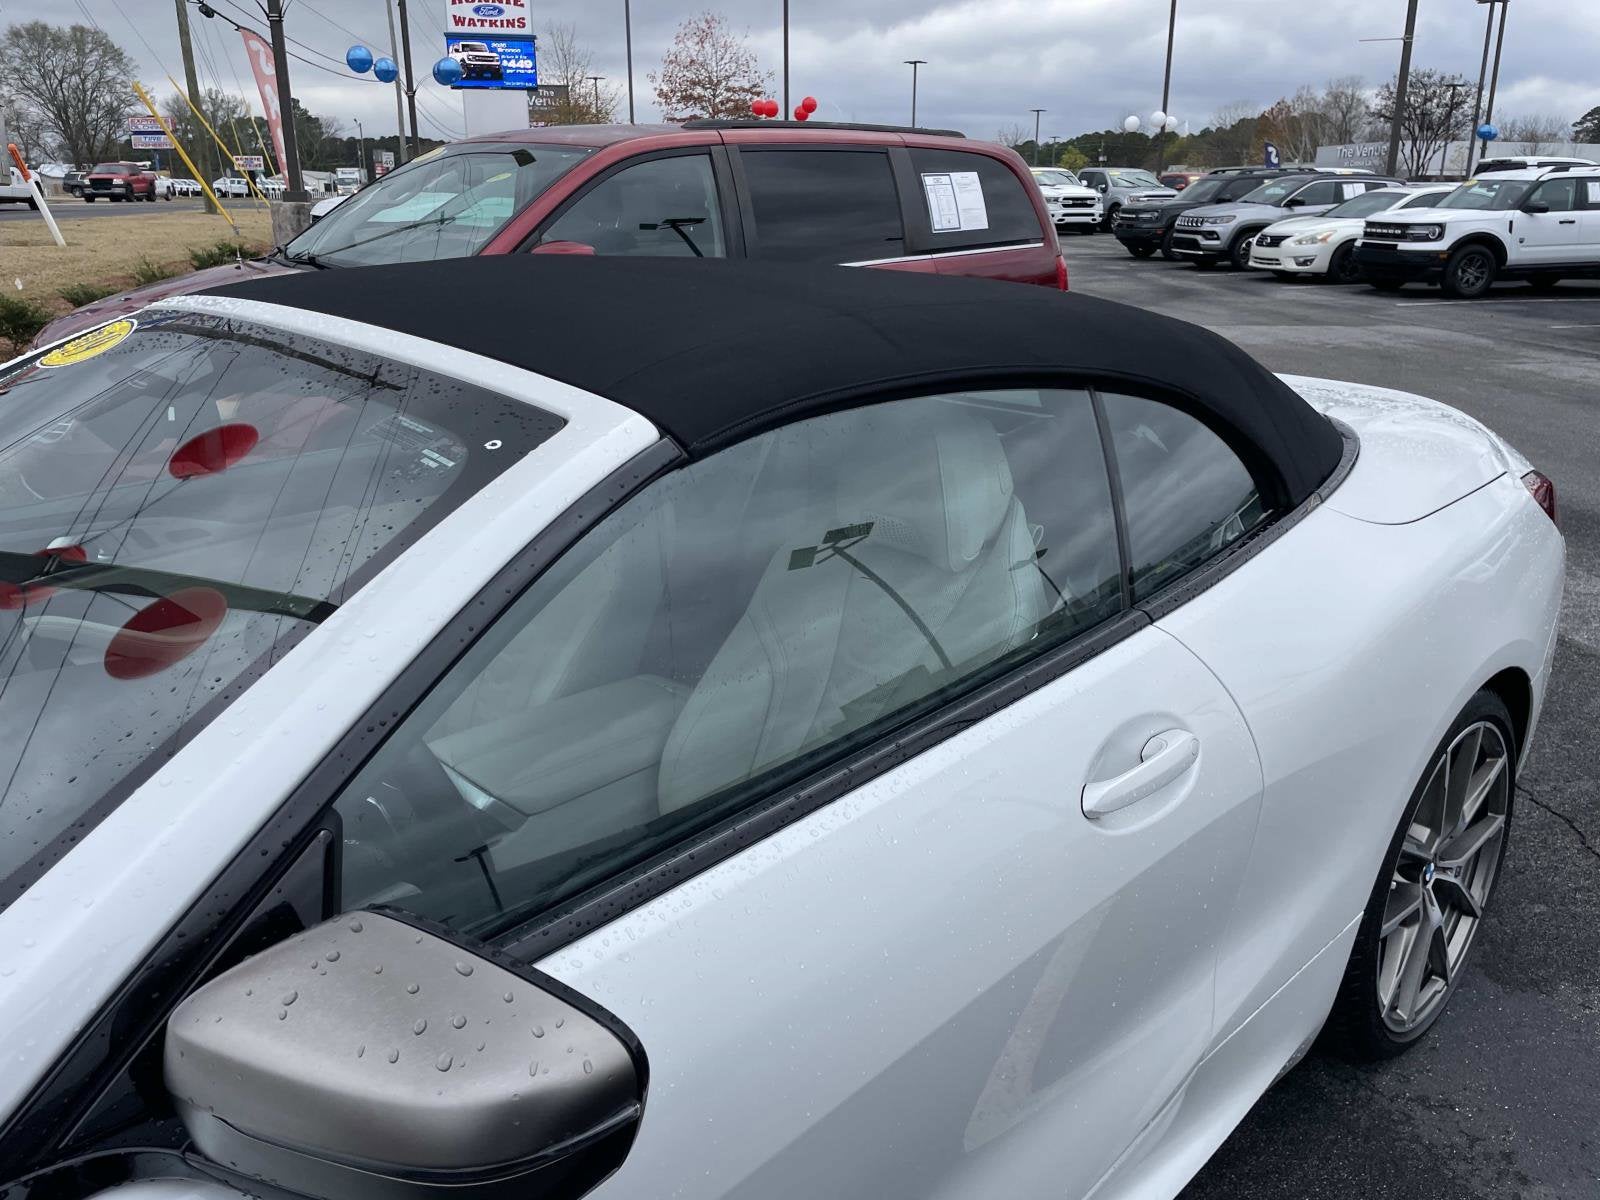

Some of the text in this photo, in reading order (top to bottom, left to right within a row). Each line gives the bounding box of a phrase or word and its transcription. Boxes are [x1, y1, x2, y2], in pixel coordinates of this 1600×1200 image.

[479, 6, 499, 15] Ford
[452, 15, 526, 28] WATKINS
[539, 89, 555, 97] The
[1337, 144, 1387, 158] The Venue
